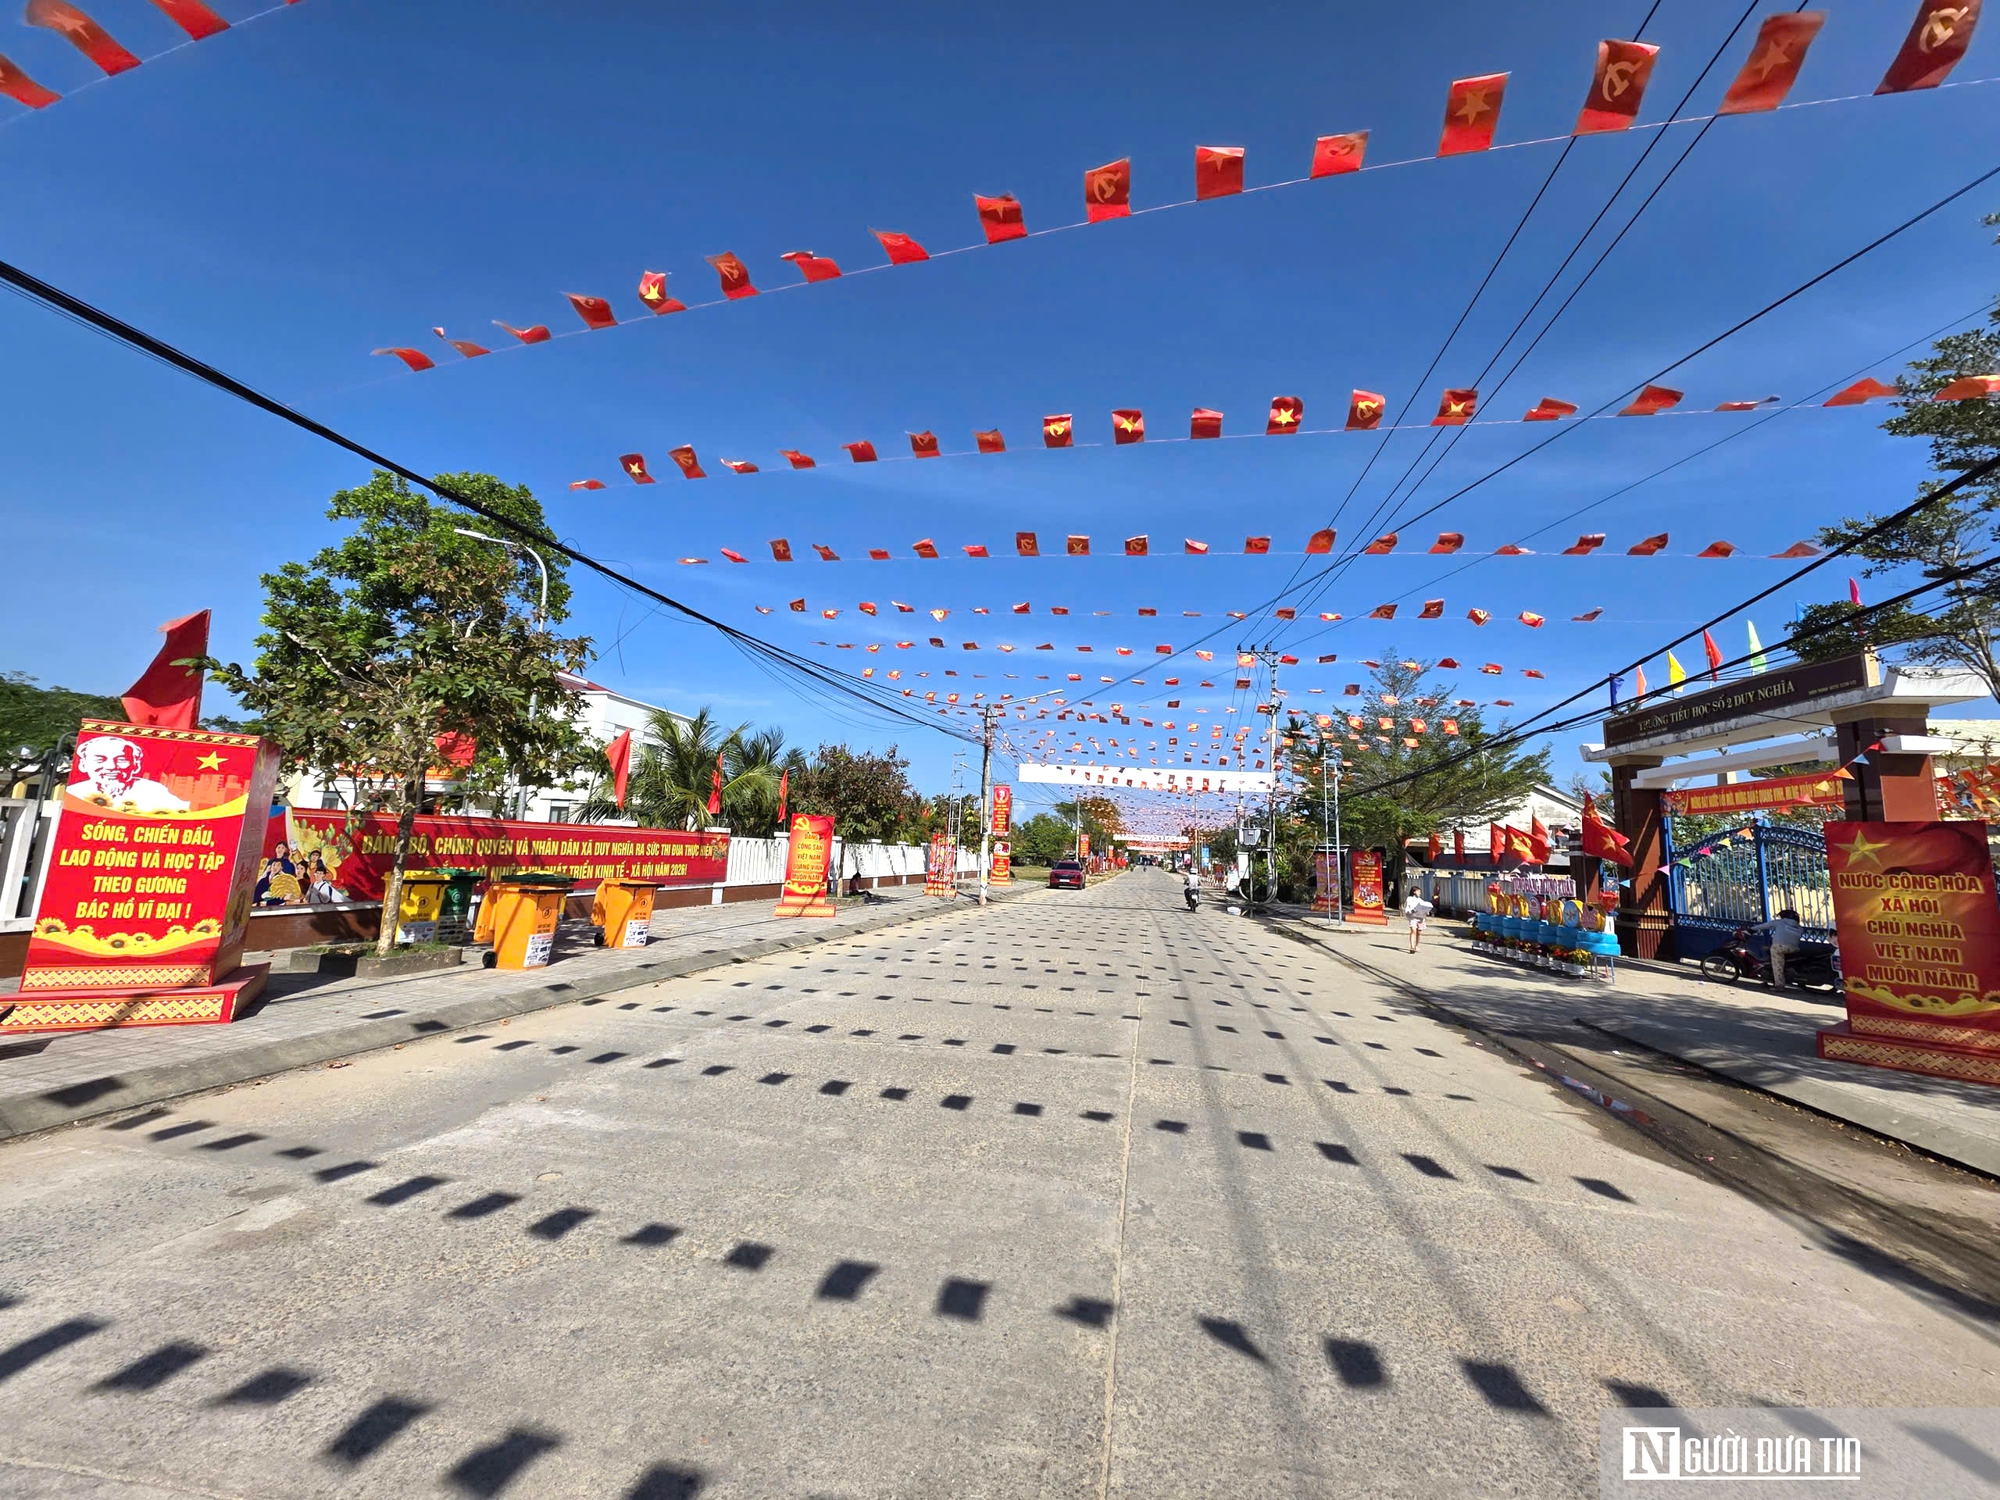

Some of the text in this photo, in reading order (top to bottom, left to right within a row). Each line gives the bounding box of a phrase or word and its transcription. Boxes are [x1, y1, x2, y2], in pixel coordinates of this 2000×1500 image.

[1670, 706, 1690, 724] TIỂU
[1692, 703, 1711, 718] HỌC
[1713, 694, 1725, 712] SỐ
[1727, 699, 1733, 708] 2
[1734, 691, 1755, 707] DUY
[1758, 680, 1795, 700] NGHĨA
[82, 820, 215, 847] SỐNG, CHIẾN ĐẤU,
[362, 829, 399, 855] ĐẢN
[409, 833, 430, 858] BỘ,
[435, 834, 473, 855] CHÍNH
[476, 835, 513, 856] QUYỀN
[516, 837, 529, 856] VÀ
[532, 838, 559, 856] NHÂN
[560, 838, 580, 856] DÂN
[581, 840, 593, 856] XÃ
[594, 842, 610, 856] DUY
[611, 840, 634, 856] NGHĨA
[635, 843, 645, 856] RA
[646, 841, 660, 856] SỨC
[661, 844, 671, 856] THI
[671, 844, 684, 856] ĐUA
[685, 844, 700, 859] THỰC
[59, 848, 225, 873] LAO ĐỘNG VÀ HỌC TẬP
[569, 859, 594, 880] TRIỂN
[595, 864, 615, 878] KINH
[616, 860, 627, 878] TẾ
[630, 862, 641, 877] XÃ
[642, 862, 654, 880] HỘI
[655, 862, 670, 877] NĂM
[670, 863, 688, 876] 2026!
[93, 875, 187, 894] THEO GƯƠNG
[1838, 872, 1982, 893] NƯỚC CỘNG HÒA
[75, 898, 109, 919] BÁC
[138, 899, 155, 919] VĨ
[156, 902, 182, 922] ĐẠI
[185, 902, 192, 919] !
[1881, 896, 1940, 917] XÃ HỘI
[1866, 917, 1963, 940] CHỦ NGHĨA
[1874, 941, 1961, 964] VIỆT NAM
[1866, 964, 1976, 989] MUÔN NĂM!
